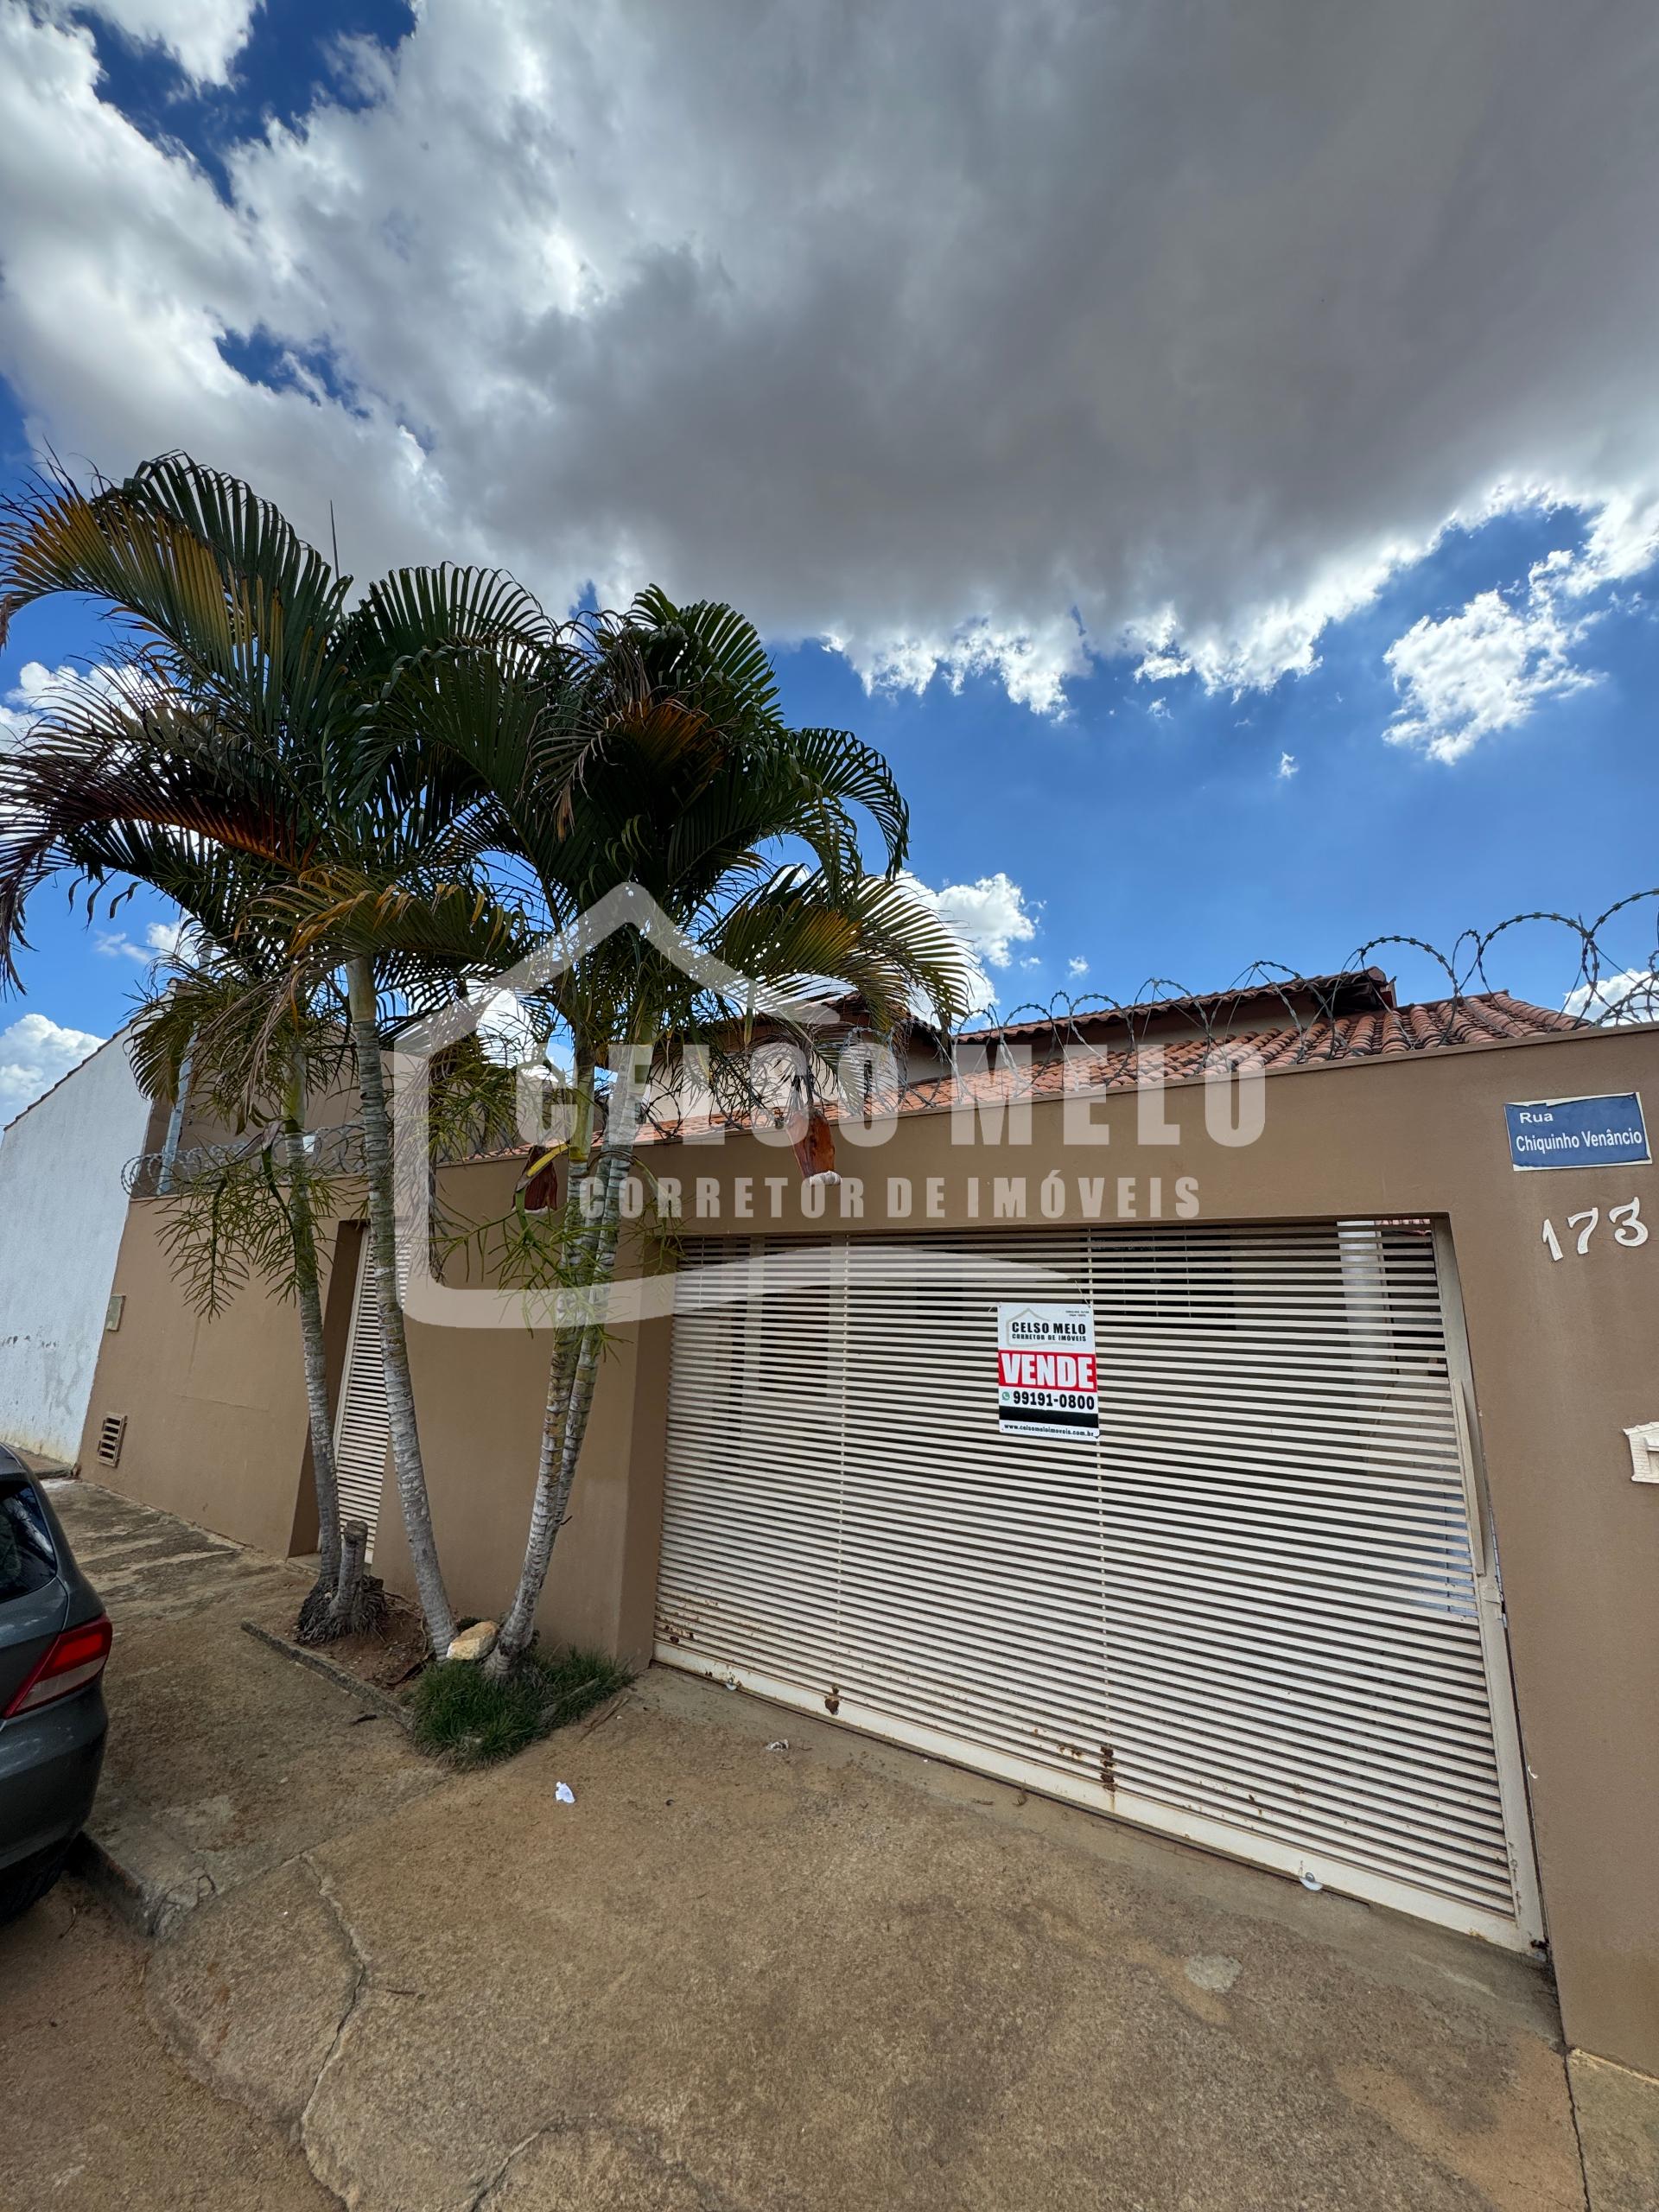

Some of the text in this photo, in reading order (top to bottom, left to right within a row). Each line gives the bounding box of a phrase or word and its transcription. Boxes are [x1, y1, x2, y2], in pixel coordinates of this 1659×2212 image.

[1519, 1111, 1554, 1124] Rua
[1516, 1127, 1643, 1154] Chiquinho Venâncio
[1542, 1196, 1649, 1262] 173
[1012, 1321, 1086, 1335] CELSO MELO
[1001, 1352, 1095, 1389] VENDE
[1013, 1390, 1095, 1410] 99191-0800
[1003, 1423, 1094, 1437] www.celsomeloimoveis.com.br
